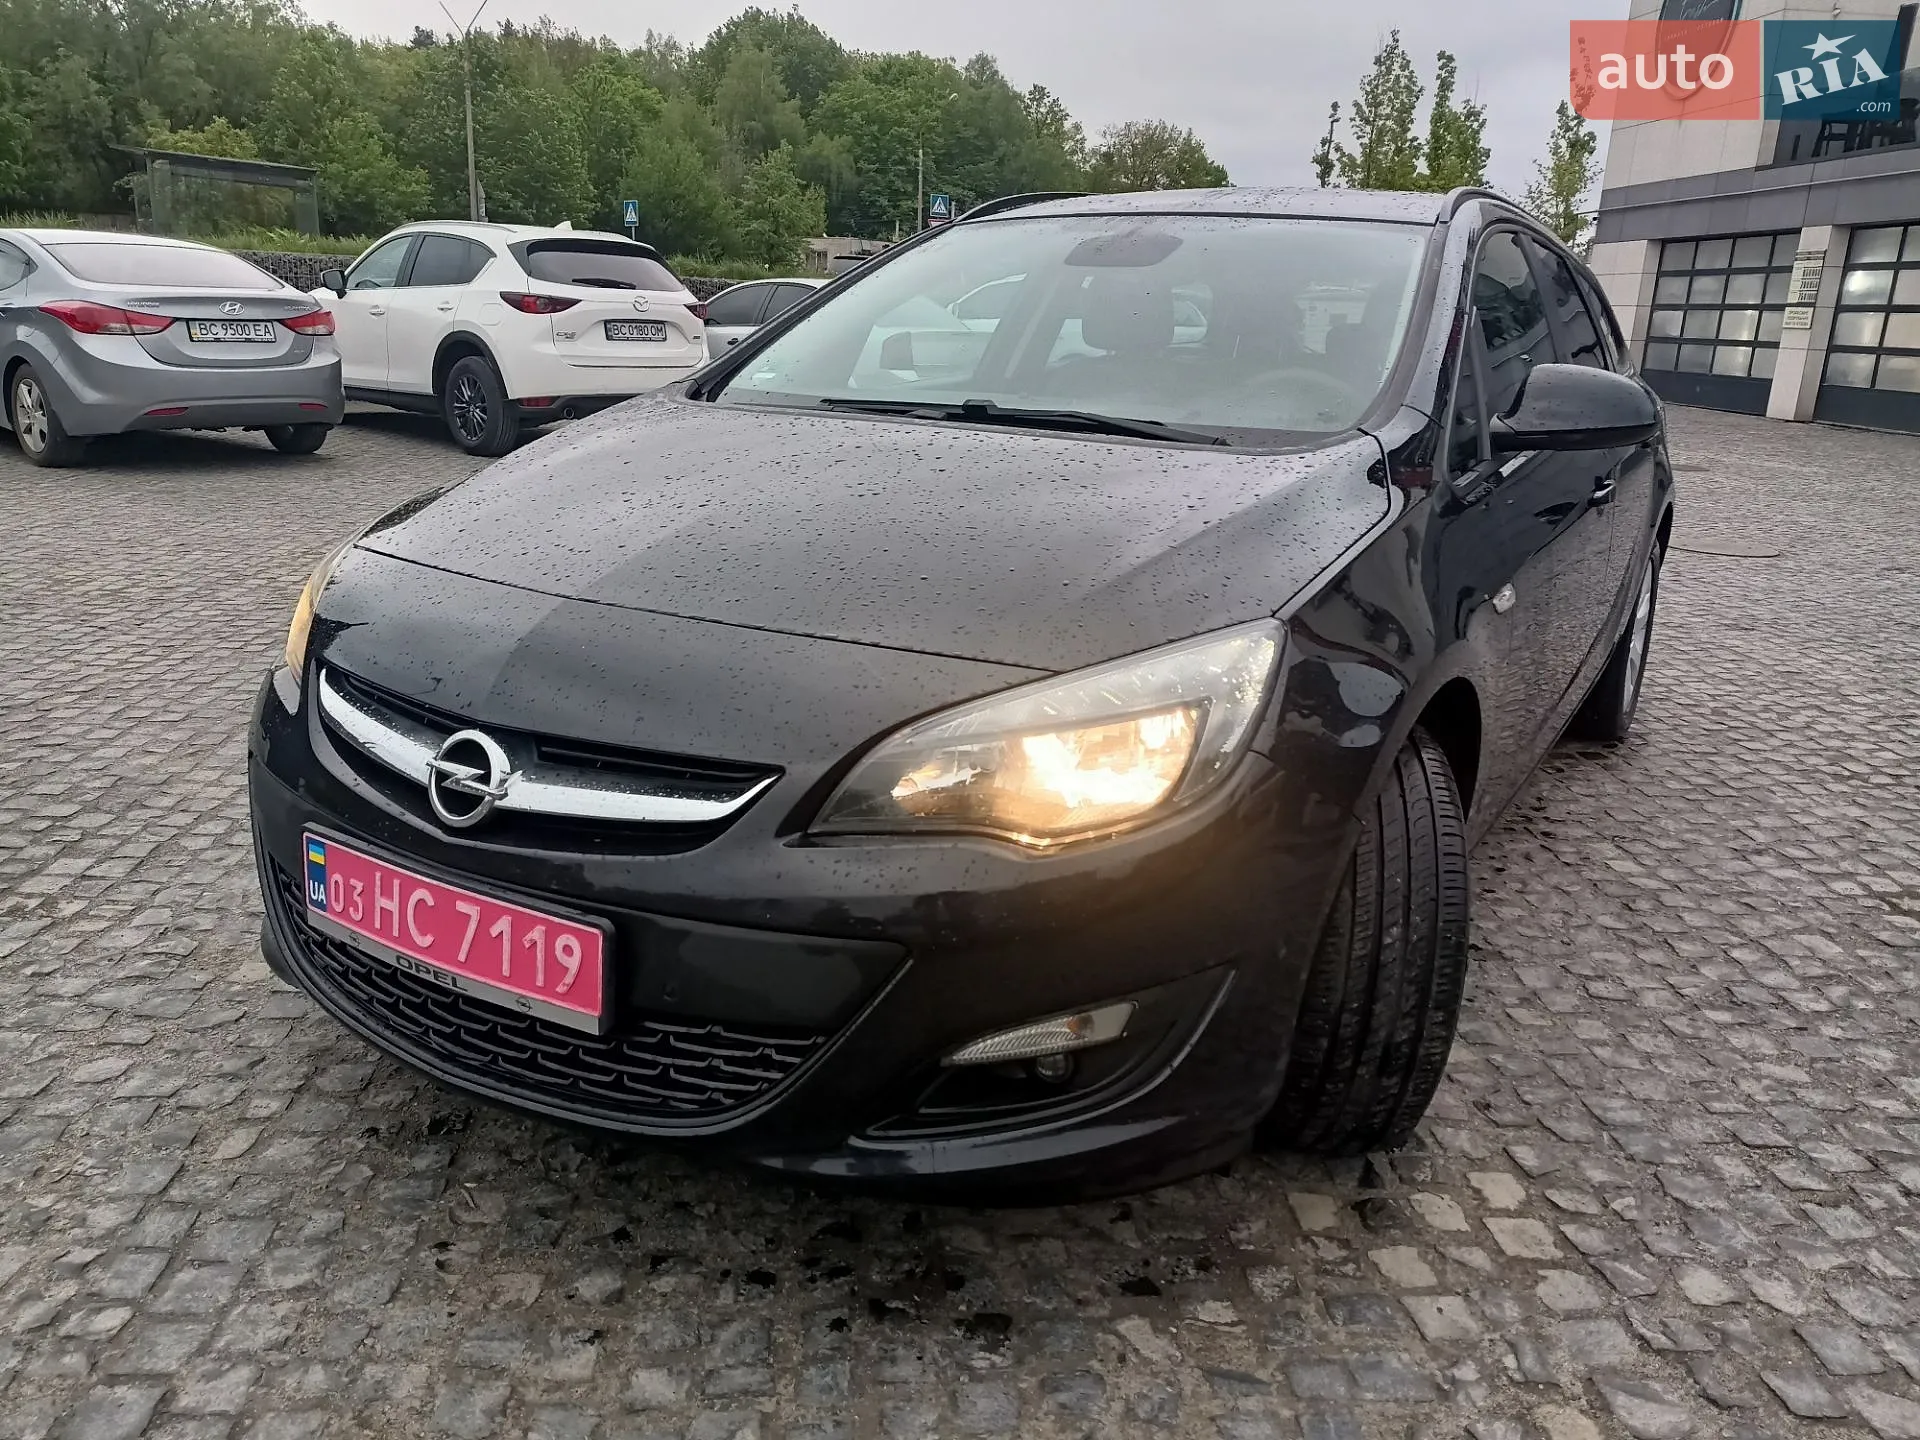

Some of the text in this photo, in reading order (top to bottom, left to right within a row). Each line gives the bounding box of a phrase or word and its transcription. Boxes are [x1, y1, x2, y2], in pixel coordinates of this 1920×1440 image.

[199, 322, 273, 337] BC 9500 EA
[613, 324, 664, 336] BC 0180 OM
[310, 879, 327, 905] UA
[455, 899, 583, 996] 7119
[395, 953, 469, 993] OPEL
